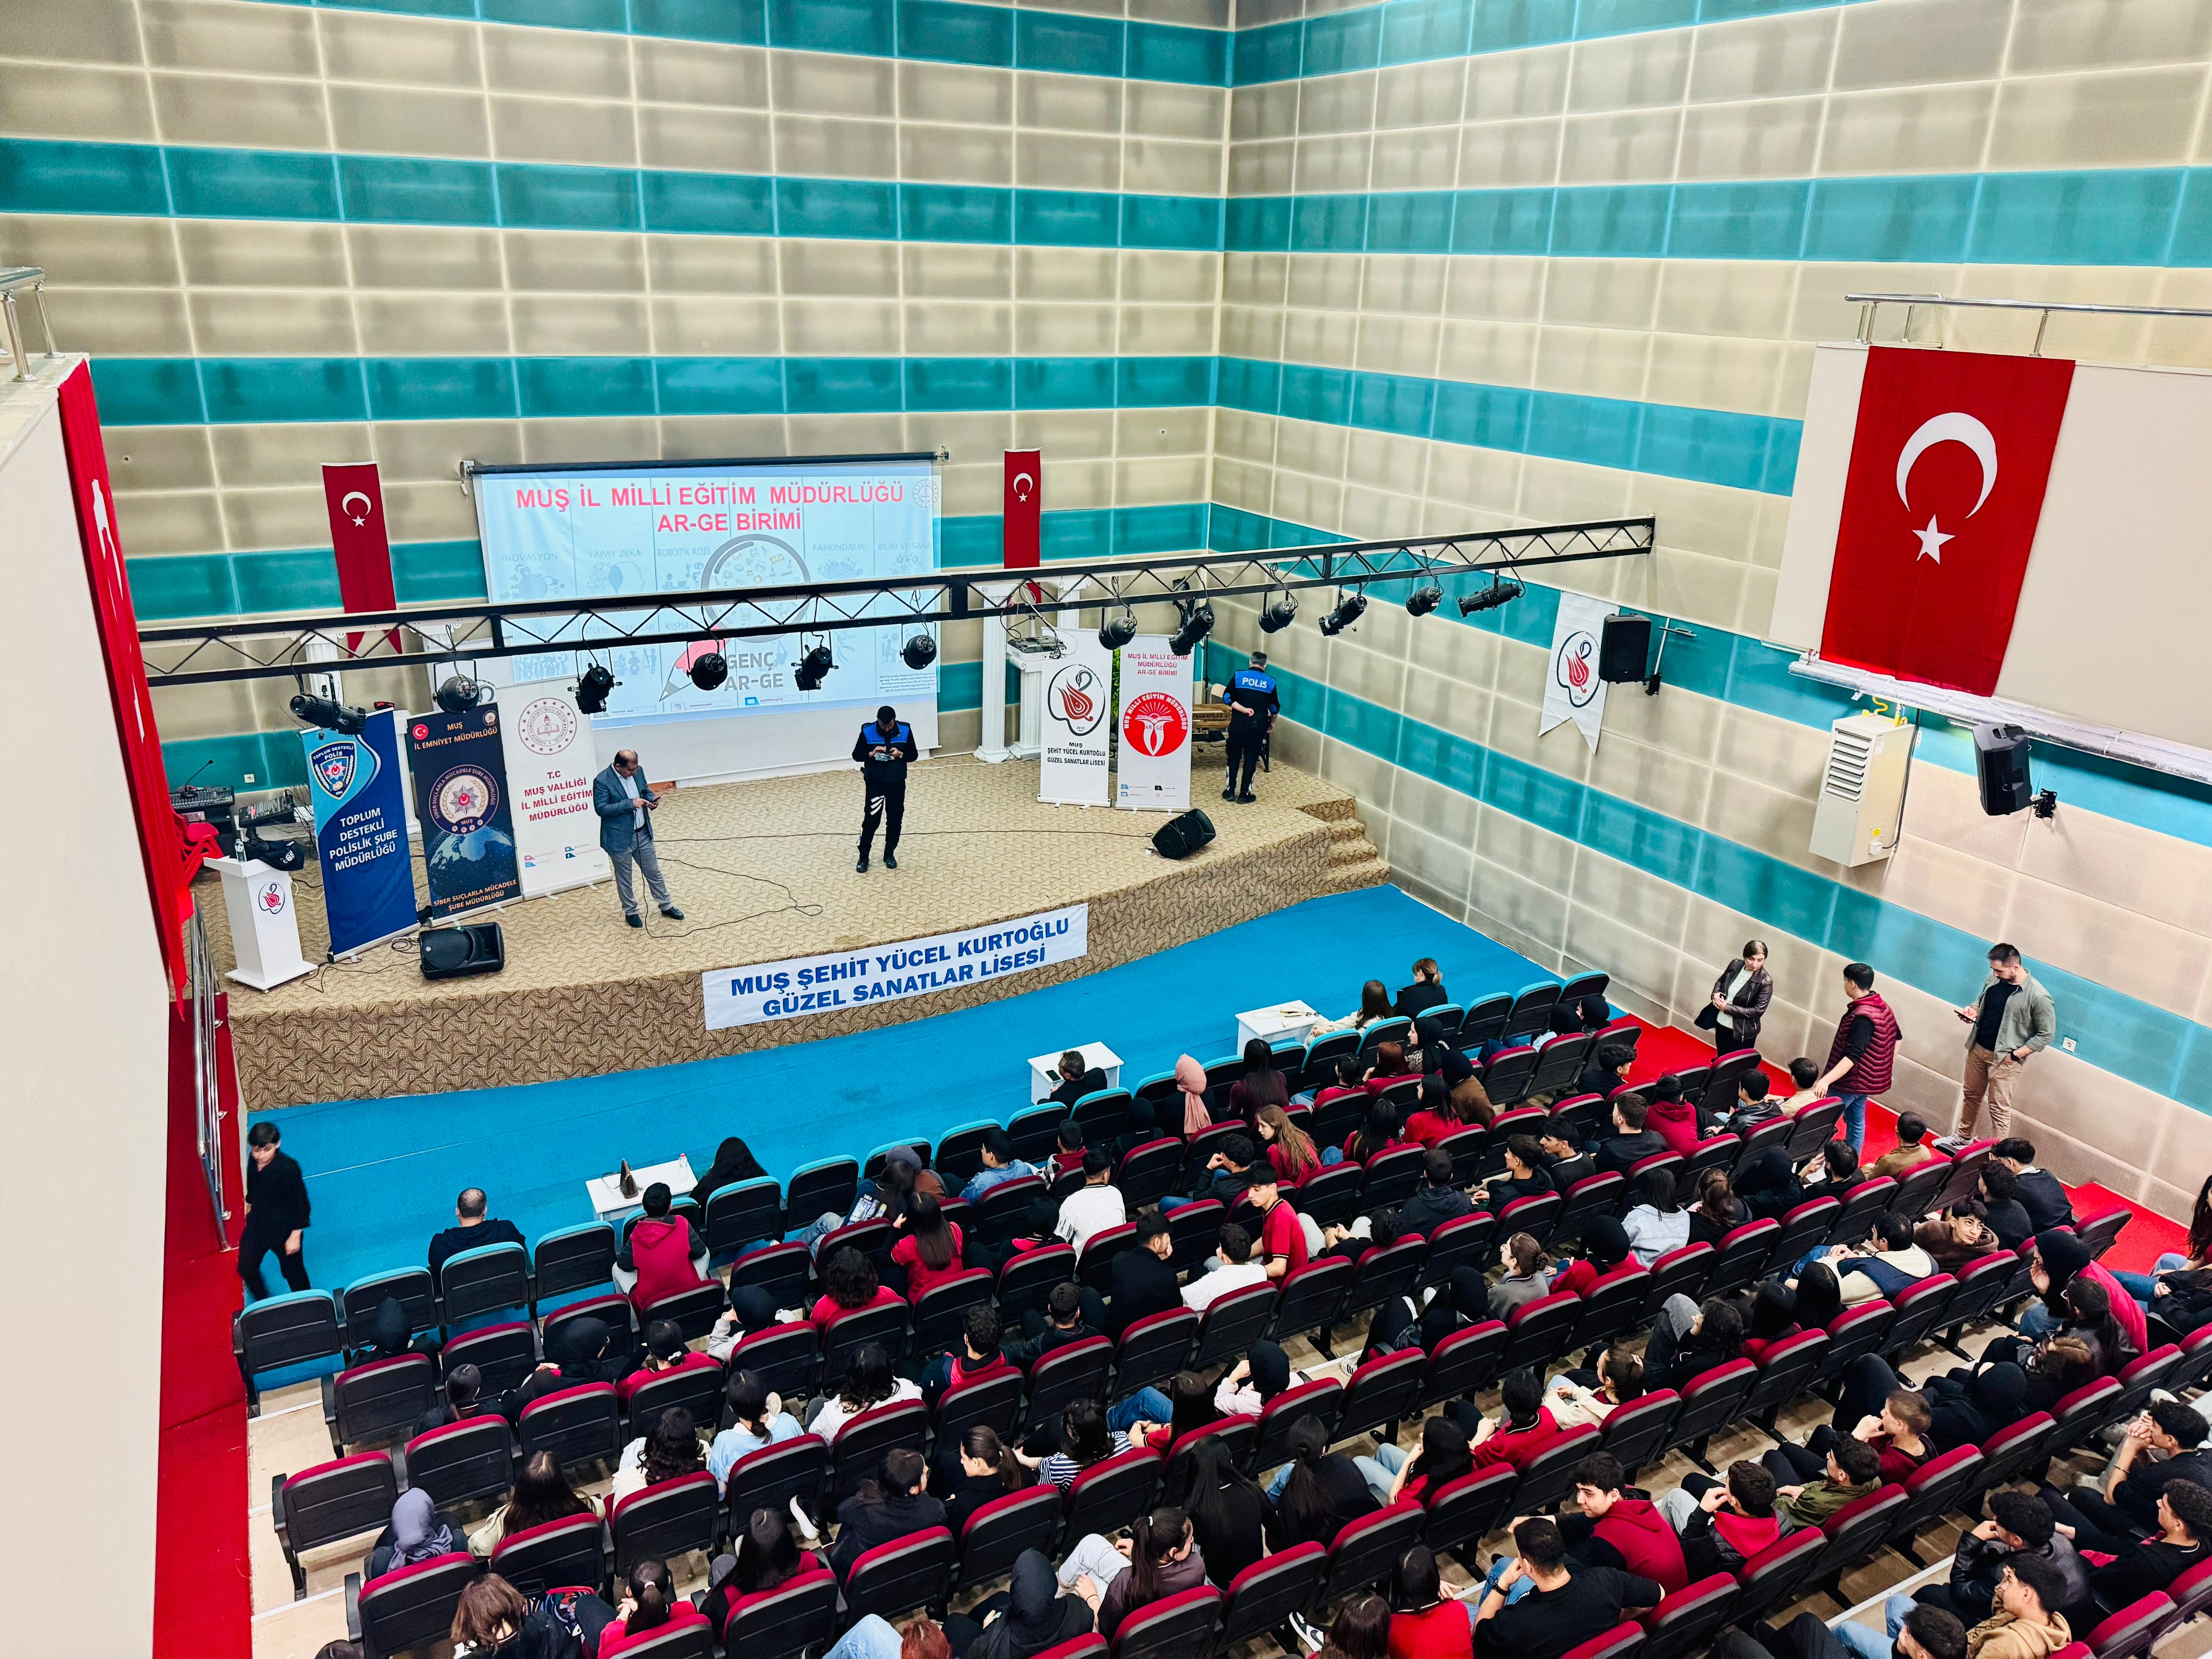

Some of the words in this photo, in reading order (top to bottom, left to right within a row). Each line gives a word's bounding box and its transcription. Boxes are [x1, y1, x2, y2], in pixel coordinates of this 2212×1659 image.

[516, 488, 570, 512] MUŞ
[579, 483, 601, 507] İL
[611, 482, 671, 506] MİLLİ
[679, 482, 756, 505] EĞİTİM
[770, 480, 903, 504] MÜDÜRLÜĞÜ
[657, 513, 728, 532] AR-GE
[737, 508, 801, 531] BİRİMİ
[588, 550, 616, 558] YAPAY
[813, 543, 865, 551] FARKINDALIK
[727, 652, 774, 671] GENÇ
[724, 673, 783, 691] AR-GE
[1242, 677, 1268, 689] POLİS
[1127, 698, 1142, 715] MİLLİ
[1142, 693, 1165, 702] EĞİTİM
[1166, 696, 1188, 730] MÜDÜRLÜĞÜ
[447, 721, 464, 731] MUŞ
[414, 739, 421, 750] İL
[422, 737, 453, 749] EMNİYET
[454, 727, 498, 742] MÜDÜRLÜĞÜ
[313, 749, 331, 760] TOPLUM
[324, 750, 343, 760] POLİS
[547, 770, 561, 779] T.C
[432, 779, 447, 805] SUÇLARLA
[445, 768, 471, 781] MÜCADELE
[472, 769, 484, 777] ŞUBE
[524, 786, 545, 797] MUŞ
[547, 776, 587, 792] VALİLİĞİ
[521, 801, 531, 810] İL
[560, 789, 592, 802] EĞİTİM
[340, 807, 381, 827] TOPLUM
[529, 802, 588, 822] MÜDÜRLÜĞÜ
[340, 817, 385, 842] DESTEKLİ
[329, 837, 372, 860] POLİSLİK
[375, 829, 398, 846] ŞUBE
[335, 841, 396, 872] MÜDÜRLÜĞÜ
[433, 897, 451, 906] SİBER
[452, 889, 483, 902] SUÇLARLA
[484, 879, 517, 893] MÜCADELE
[448, 902, 464, 913] ŞUBE
[465, 890, 505, 906] MÜDÜRLÜĞÜ
[731, 972, 790, 996] MUŞ
[797, 957, 869, 990] ŞEHİT
[875, 948, 951, 973] YÜCEL
[957, 917, 1069, 958] KURTOĞLU
[763, 992, 846, 1016] GÜZEL
[852, 964, 973, 1001] SANATLAR
[981, 943, 1046, 976] LİSESİ
